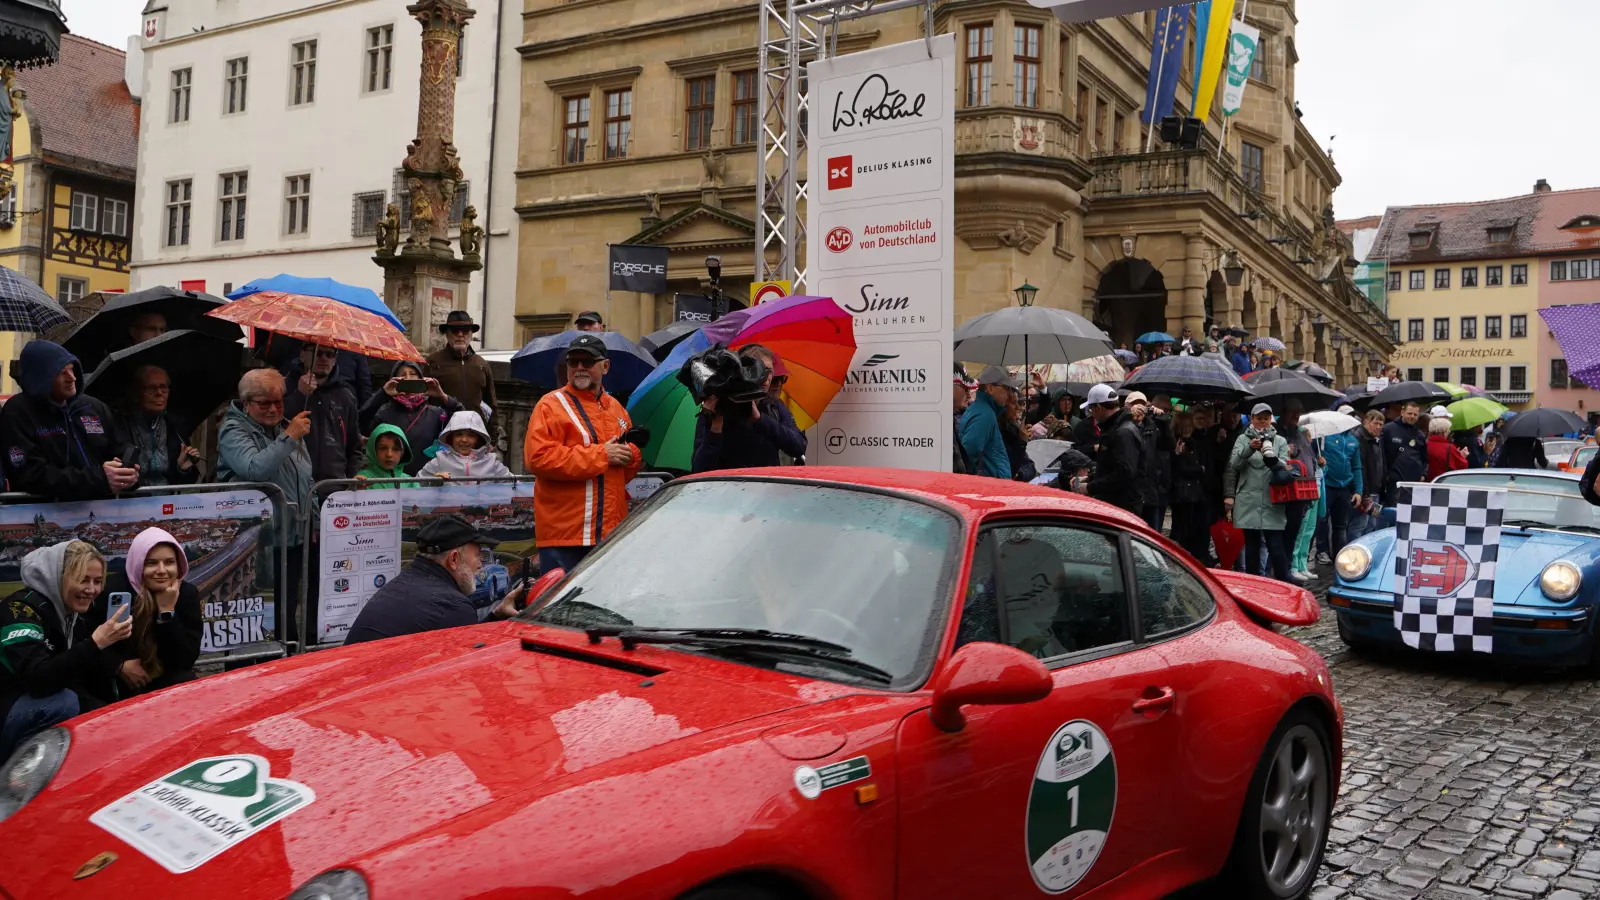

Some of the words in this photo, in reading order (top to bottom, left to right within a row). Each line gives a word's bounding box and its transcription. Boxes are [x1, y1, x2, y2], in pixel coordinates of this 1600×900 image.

[857, 162, 889, 174] DELIUS
[892, 157, 932, 169] KLASING
[864, 218, 932, 236] Automobilclub
[859, 239, 876, 249] von
[879, 232, 936, 248] Deutschland
[613, 262, 664, 274] PORSCHE
[844, 284, 909, 313] Sinn
[854, 315, 925, 327] ZIALUHREN
[1441, 348, 1514, 358] Marktplatz
[844, 369, 926, 384] ANTAENIUS
[850, 436, 889, 447] CLASSIC
[893, 437, 934, 448] TRADER
[216, 498, 254, 507] PORSCHE
[348, 534, 374, 546] Sinn
[201, 596, 264, 619] .05.2023
[200, 615, 264, 649] ASSIK
[218, 765, 238, 778] 1
[1067, 784, 1079, 829] 1
